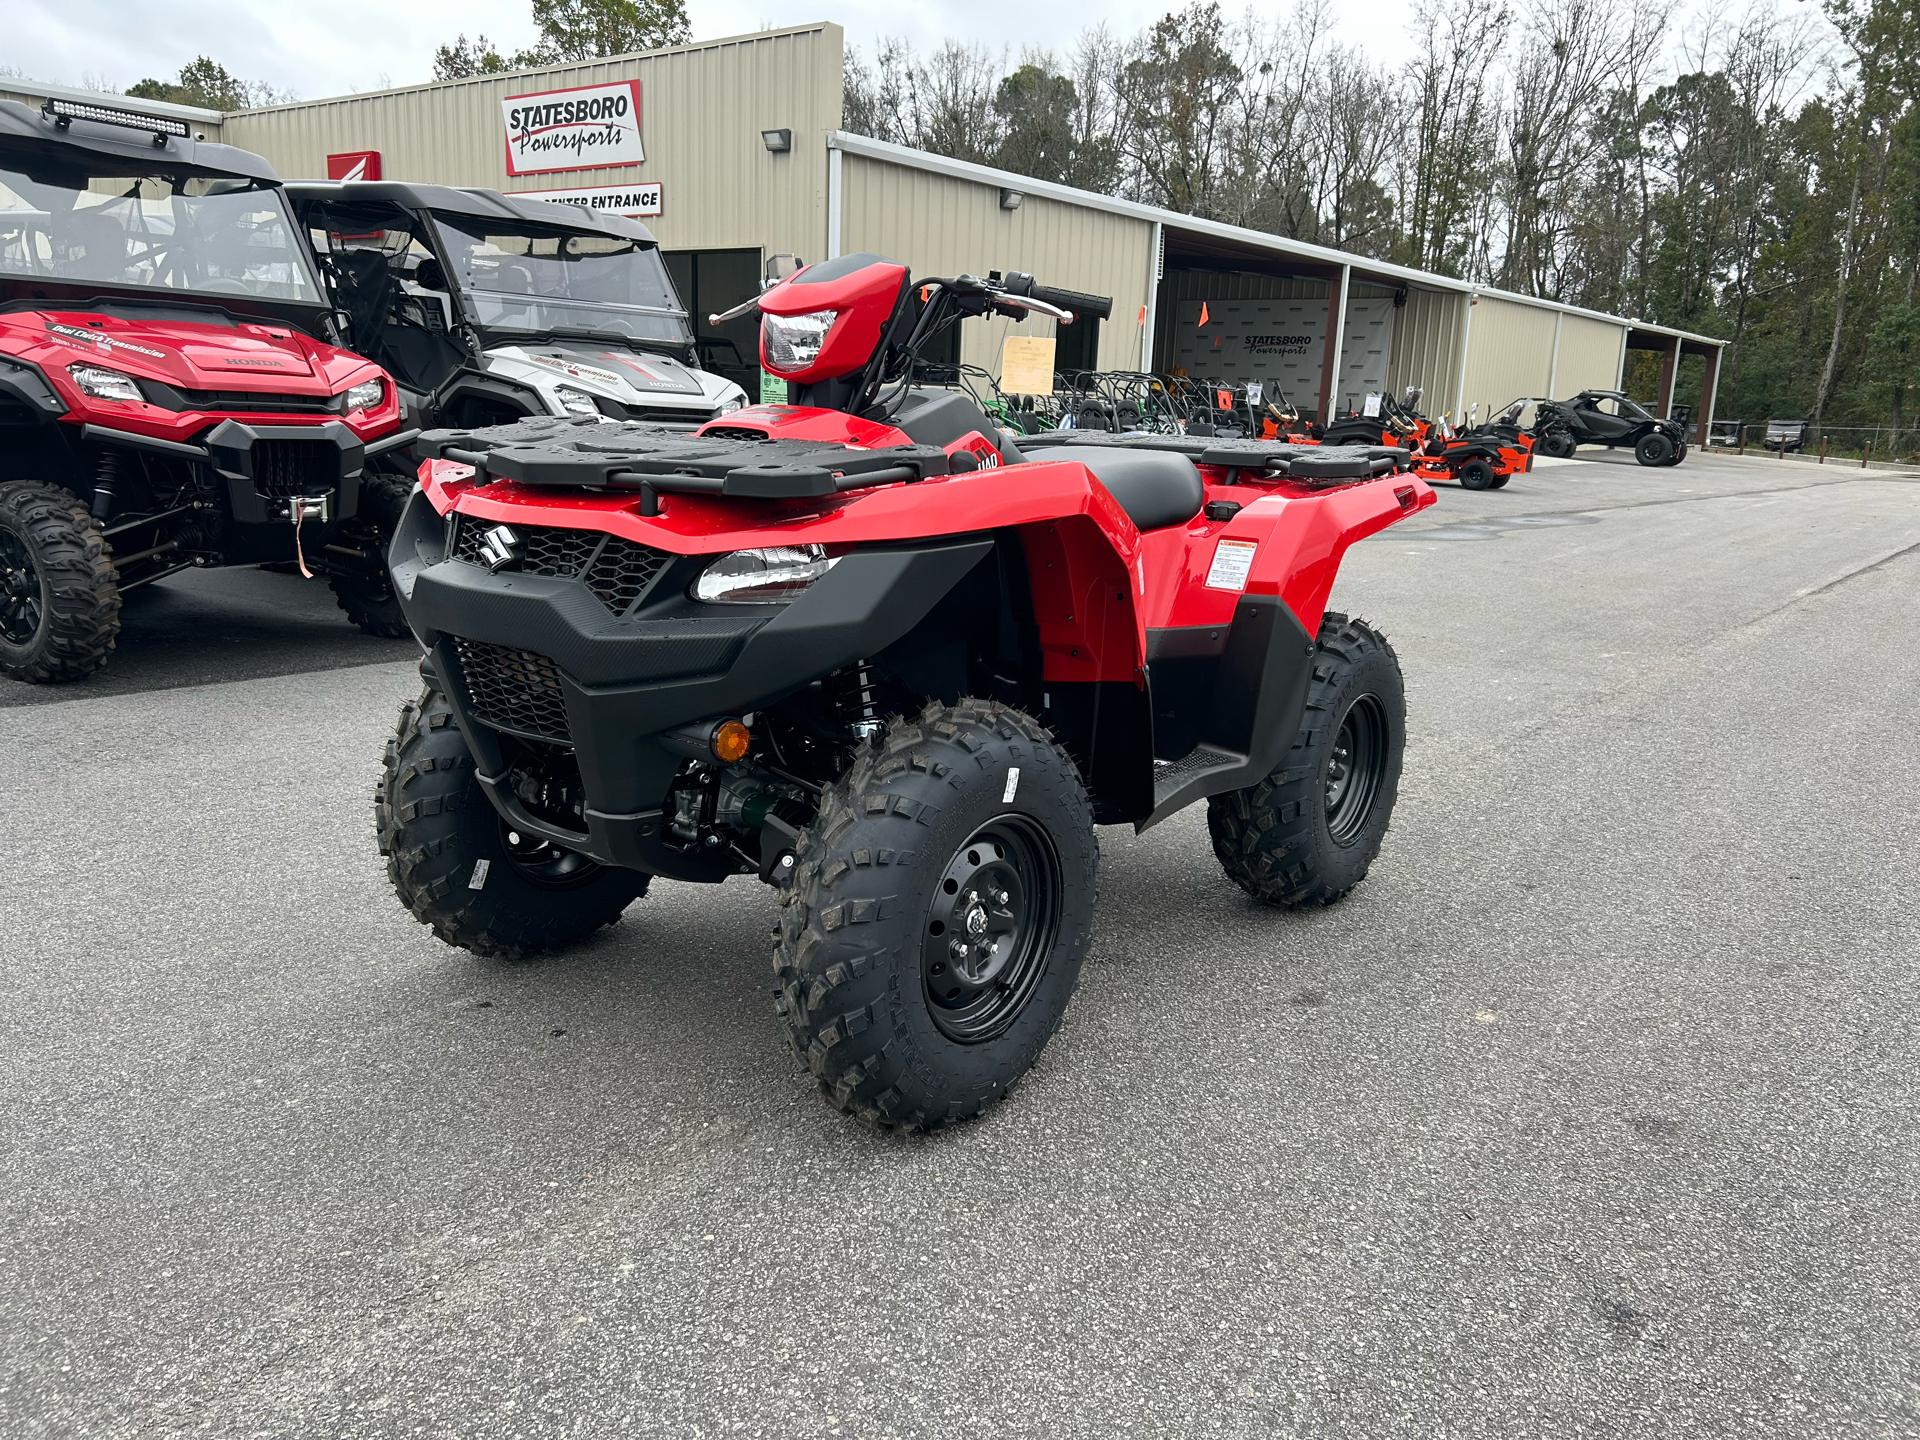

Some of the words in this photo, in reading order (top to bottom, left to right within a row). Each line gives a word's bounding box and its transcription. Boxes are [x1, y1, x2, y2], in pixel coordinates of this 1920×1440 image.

[510, 95, 628, 130] STATESBORO
[520, 121, 623, 157] Powersports
[591, 192, 658, 209] ENTRANCE
[52, 325, 75, 336] Dual
[74, 330, 105, 342] Clutch
[102, 337, 166, 359] Transmission
[1245, 335, 1312, 345] STATESBORO
[1249, 343, 1307, 358] Powersports
[224, 358, 285, 368] HONDA
[550, 360, 573, 369] Clutch
[573, 365, 618, 381] Transmission
[649, 381, 686, 389] HONDA
